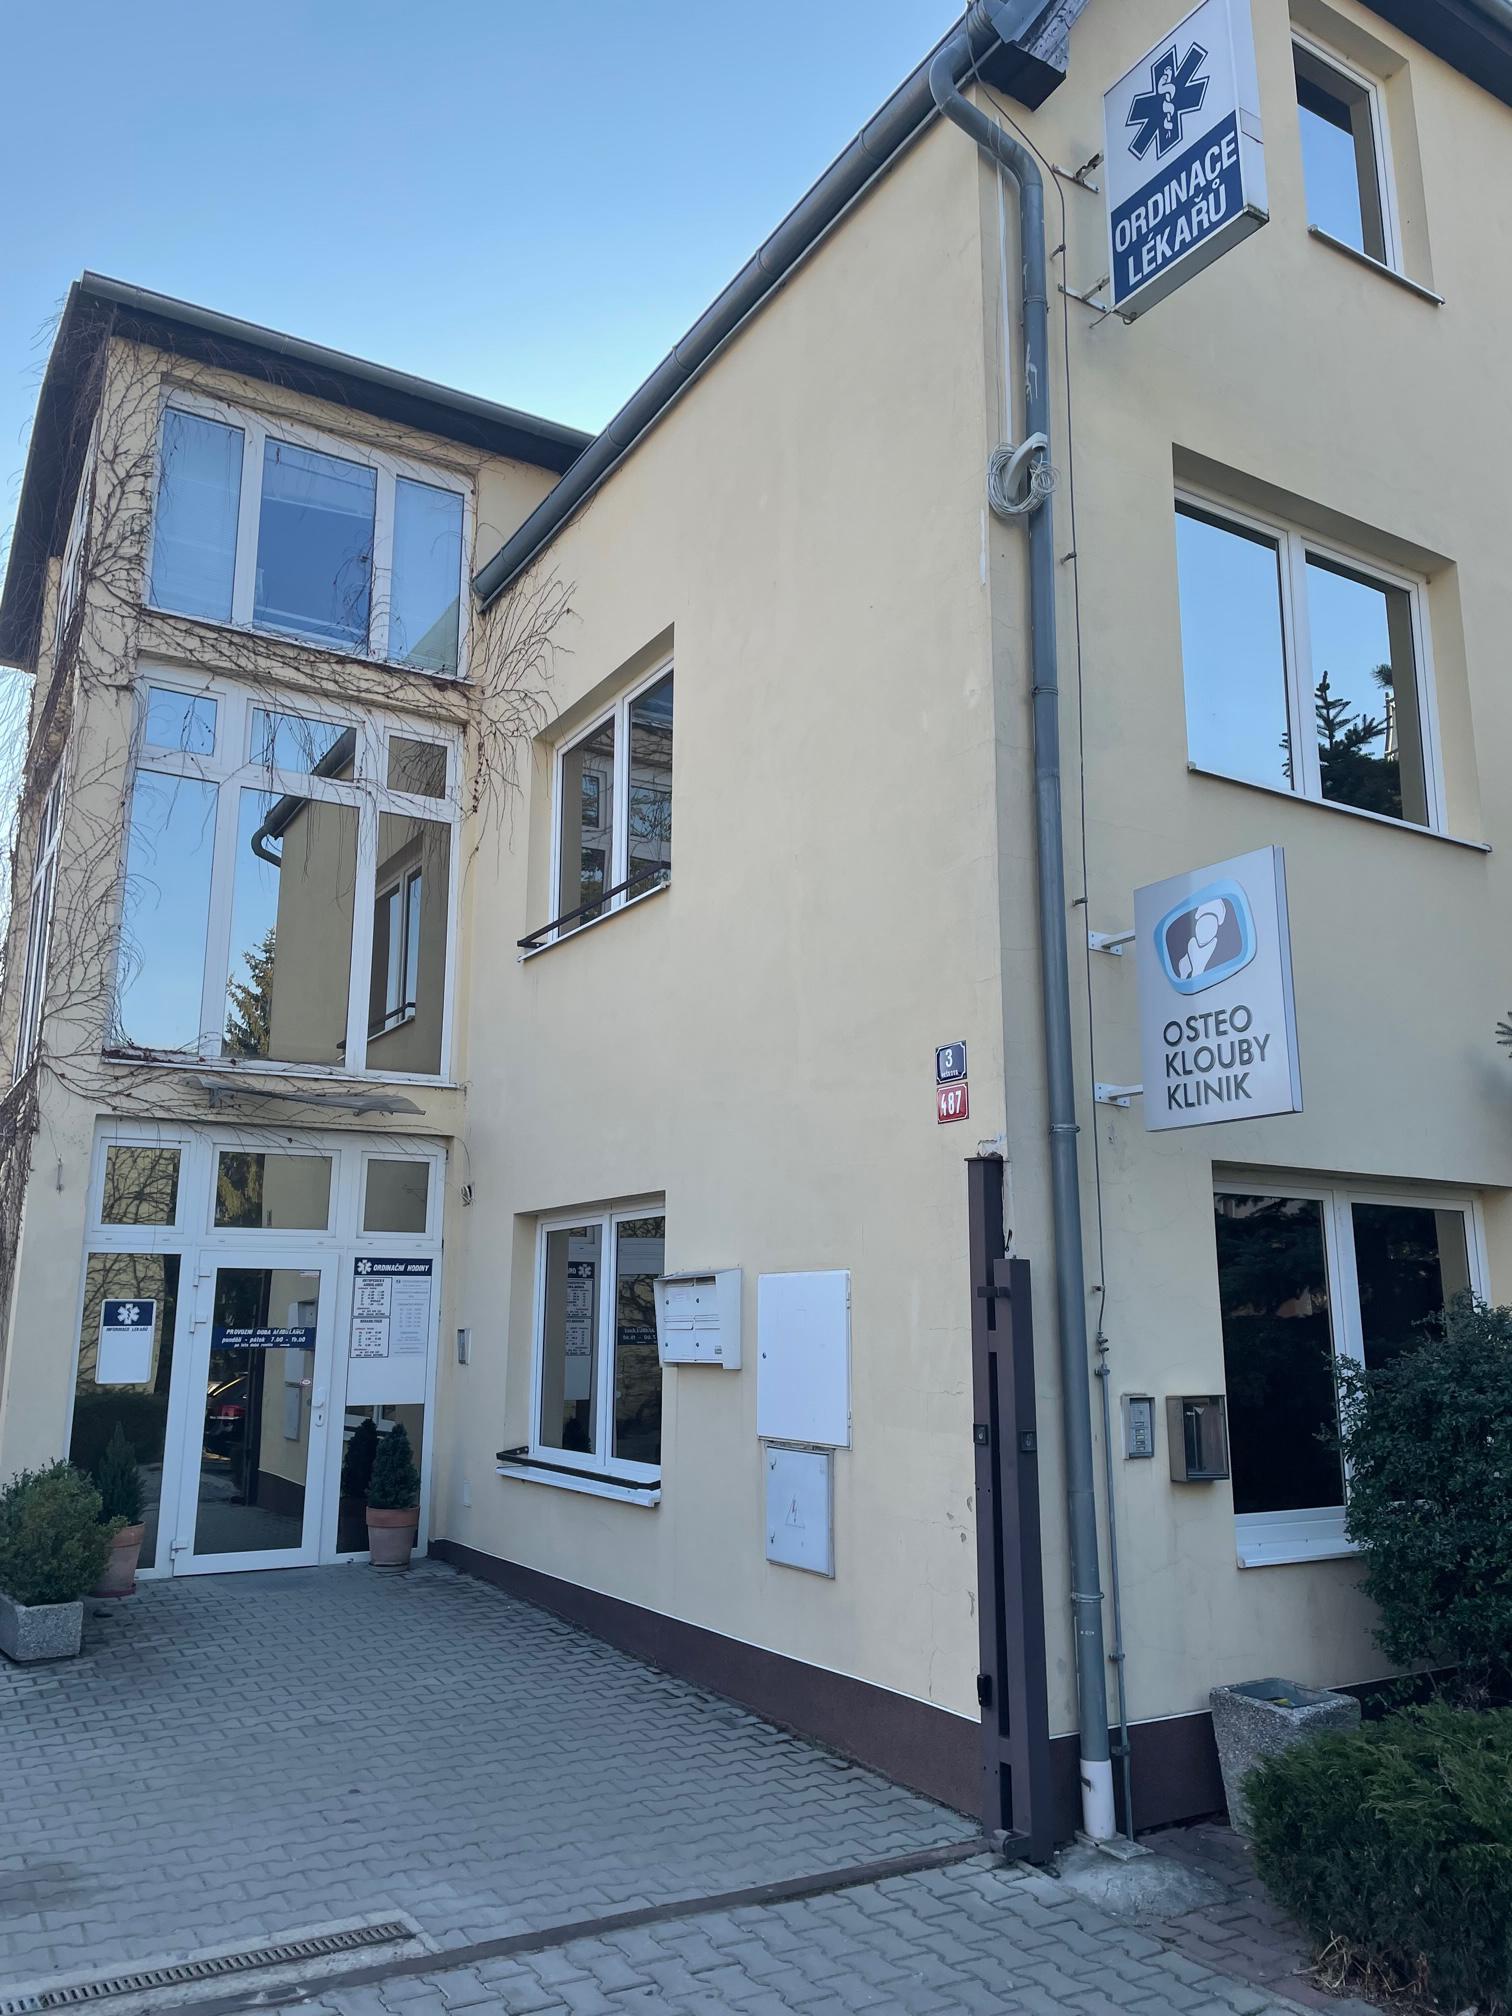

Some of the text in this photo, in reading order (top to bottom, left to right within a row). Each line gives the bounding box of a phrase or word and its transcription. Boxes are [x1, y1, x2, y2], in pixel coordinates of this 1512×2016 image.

[1114, 130, 1239, 253] ORDINACE
[1127, 178, 1227, 287] LÉKAŘŮ
[1163, 1004, 1252, 1047] OSTEO
[945, 1048, 953, 1068] 3
[1165, 1034, 1271, 1078] KLOUBY
[941, 1090, 961, 1116] 487
[1167, 1072, 1253, 1110] KLINIK
[373, 1263, 405, 1271] ORDINAČNÍ
